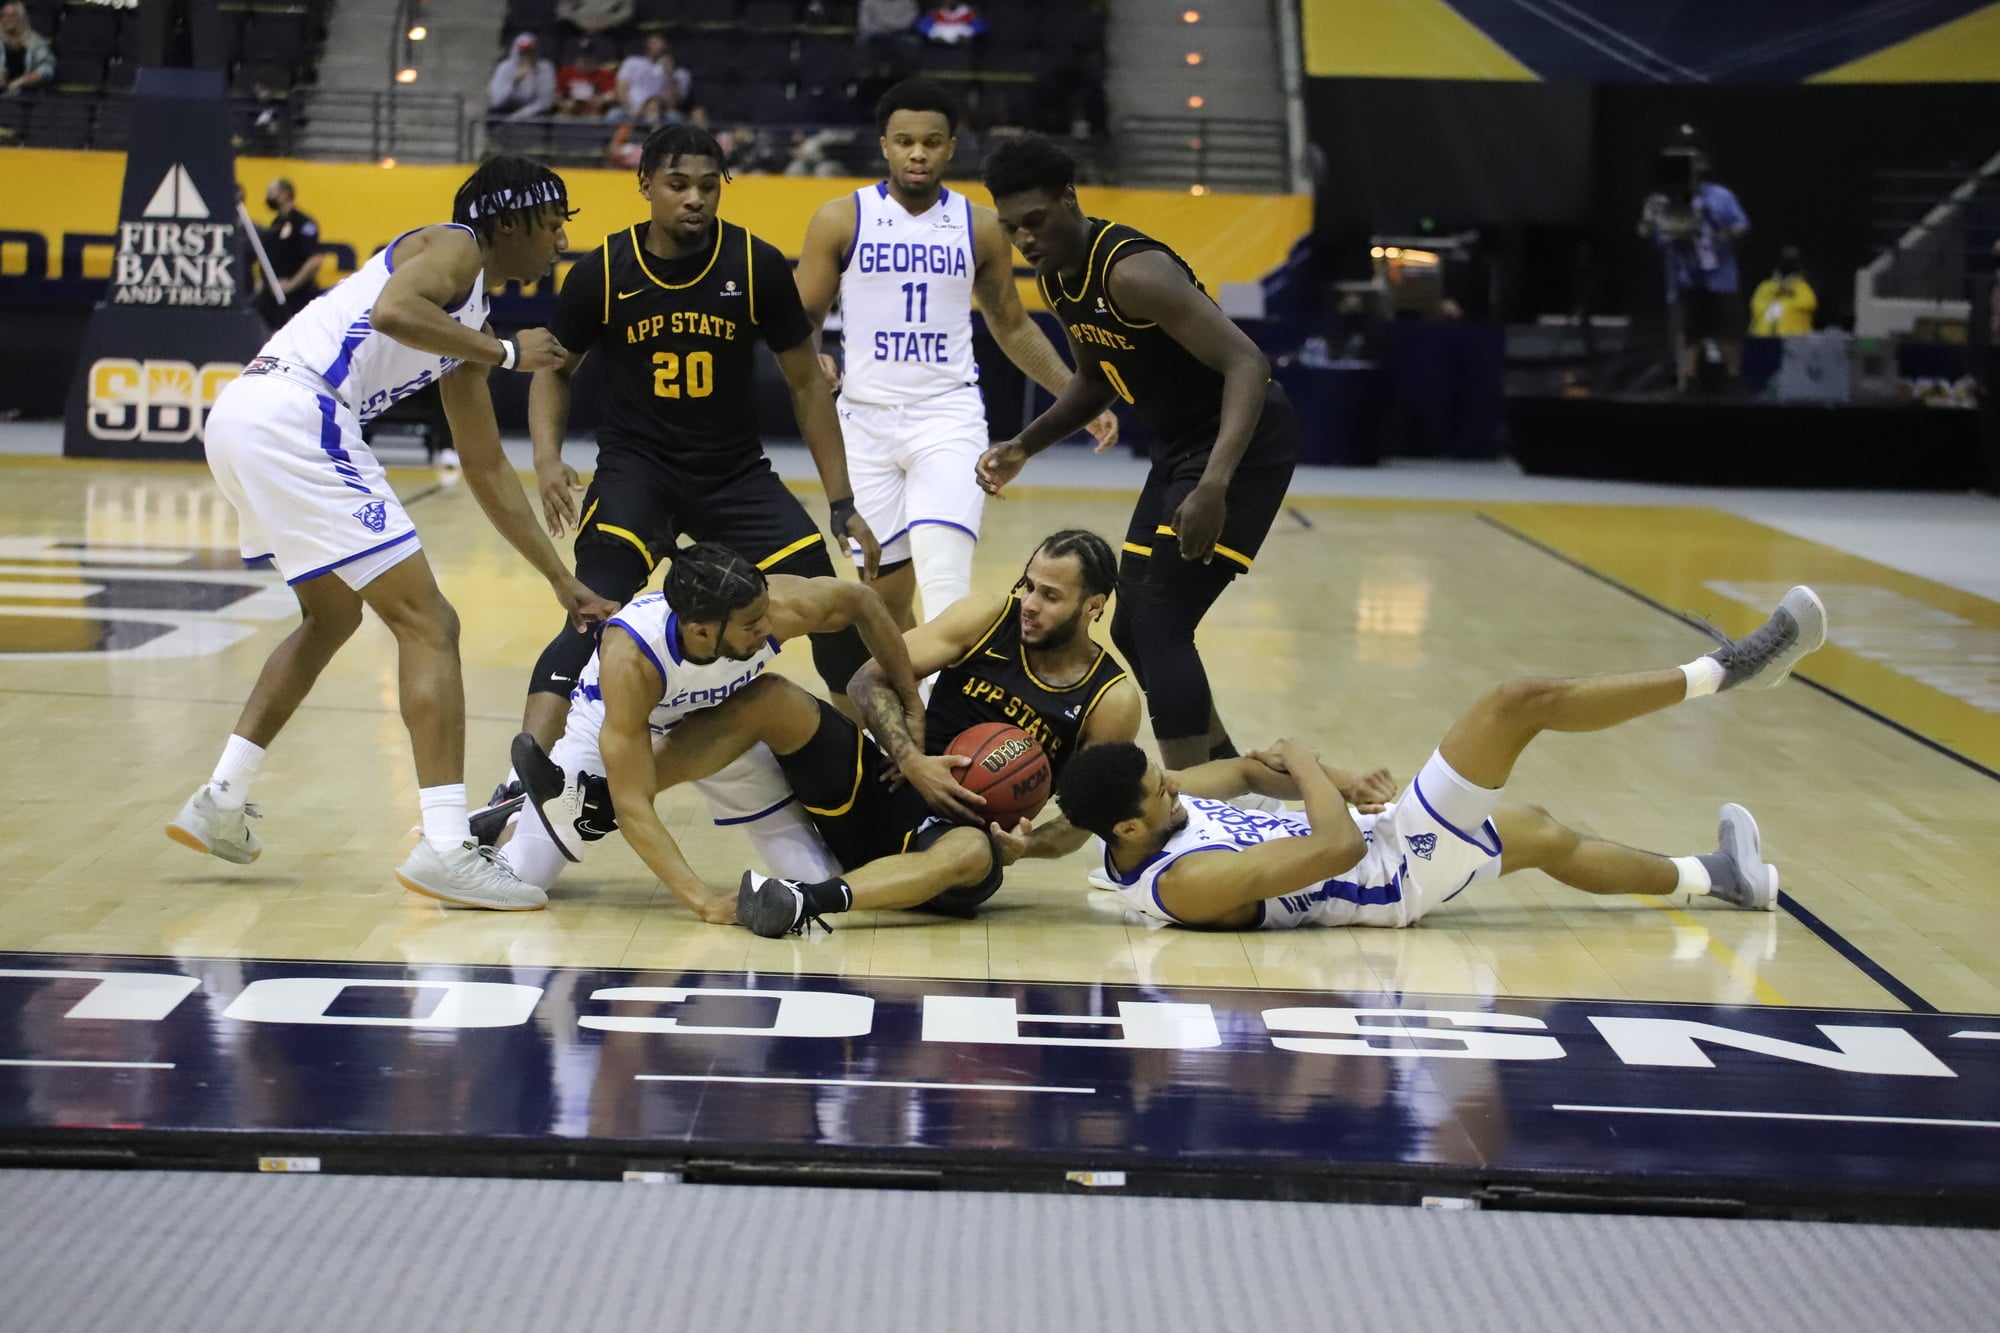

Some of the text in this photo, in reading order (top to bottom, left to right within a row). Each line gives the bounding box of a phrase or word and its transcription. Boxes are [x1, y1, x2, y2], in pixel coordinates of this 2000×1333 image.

[119, 221, 234, 257] FIRST
[114, 253, 236, 287] BANK
[858, 243, 967, 278] GEORGIA
[113, 284, 234, 307] AND TRUST
[901, 282, 928, 323] 11
[626, 311, 737, 344] APP STATE
[1080, 323, 1136, 350] STATE
[874, 331, 948, 363] STATE
[652, 351, 714, 399] 20
[1099, 361, 1135, 404] 0
[961, 676, 1005, 704] APP
